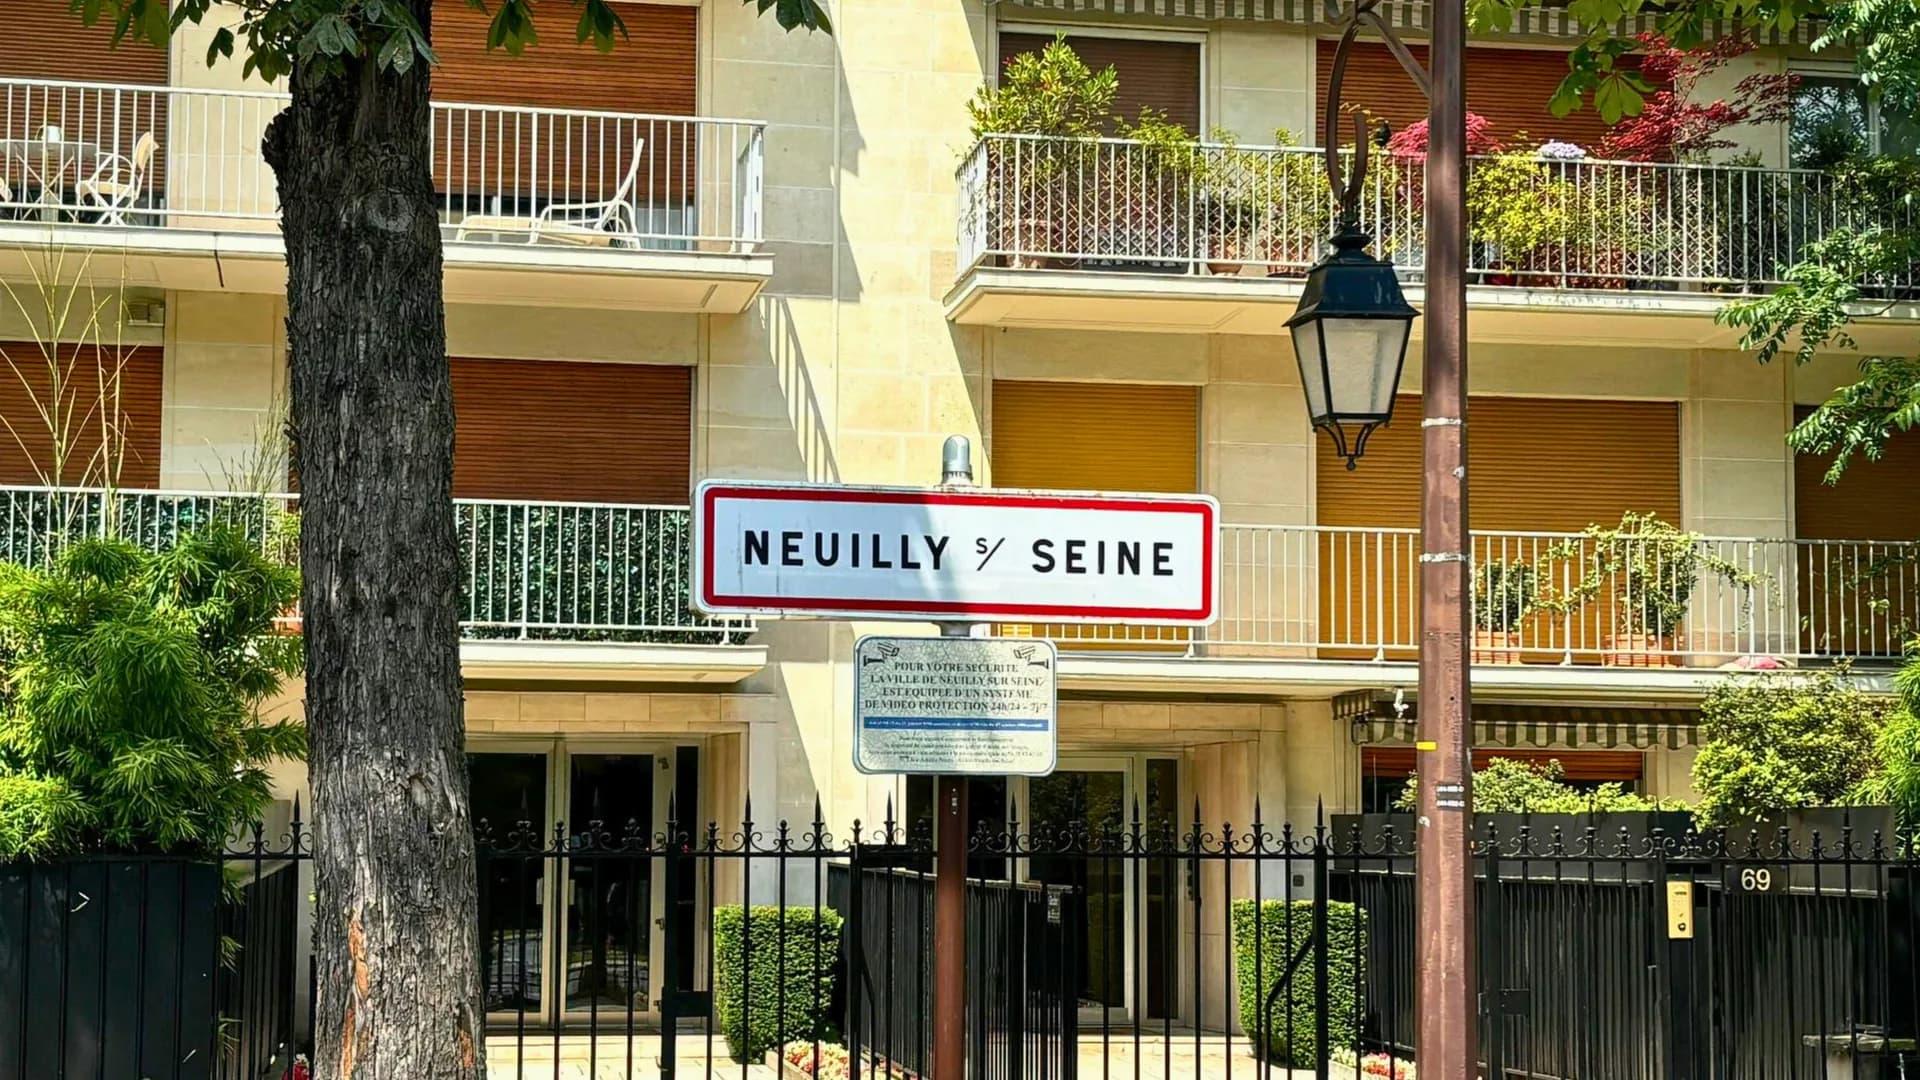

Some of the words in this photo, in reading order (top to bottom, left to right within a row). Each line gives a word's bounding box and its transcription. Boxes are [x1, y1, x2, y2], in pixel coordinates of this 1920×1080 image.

[744, 530, 950, 571] NEUILLY
[1032, 538, 1174, 576] SEINE
[894, 662, 924, 672] POUR
[926, 662, 962, 673] VOTRE
[871, 675, 885, 683] LA
[886, 675, 919, 684] VILLE
[922, 675, 937, 684] DE
[939, 676, 986, 686] NEUILLY
[986, 677, 1008, 686] SUR
[1010, 677, 1045, 687] SEINE
[883, 687, 904, 697] EST
[954, 688, 981, 698] D'UN
[865, 700, 880, 709] DE
[919, 701, 989, 711] PROTECTION
[1741, 868, 1771, 892] 69
